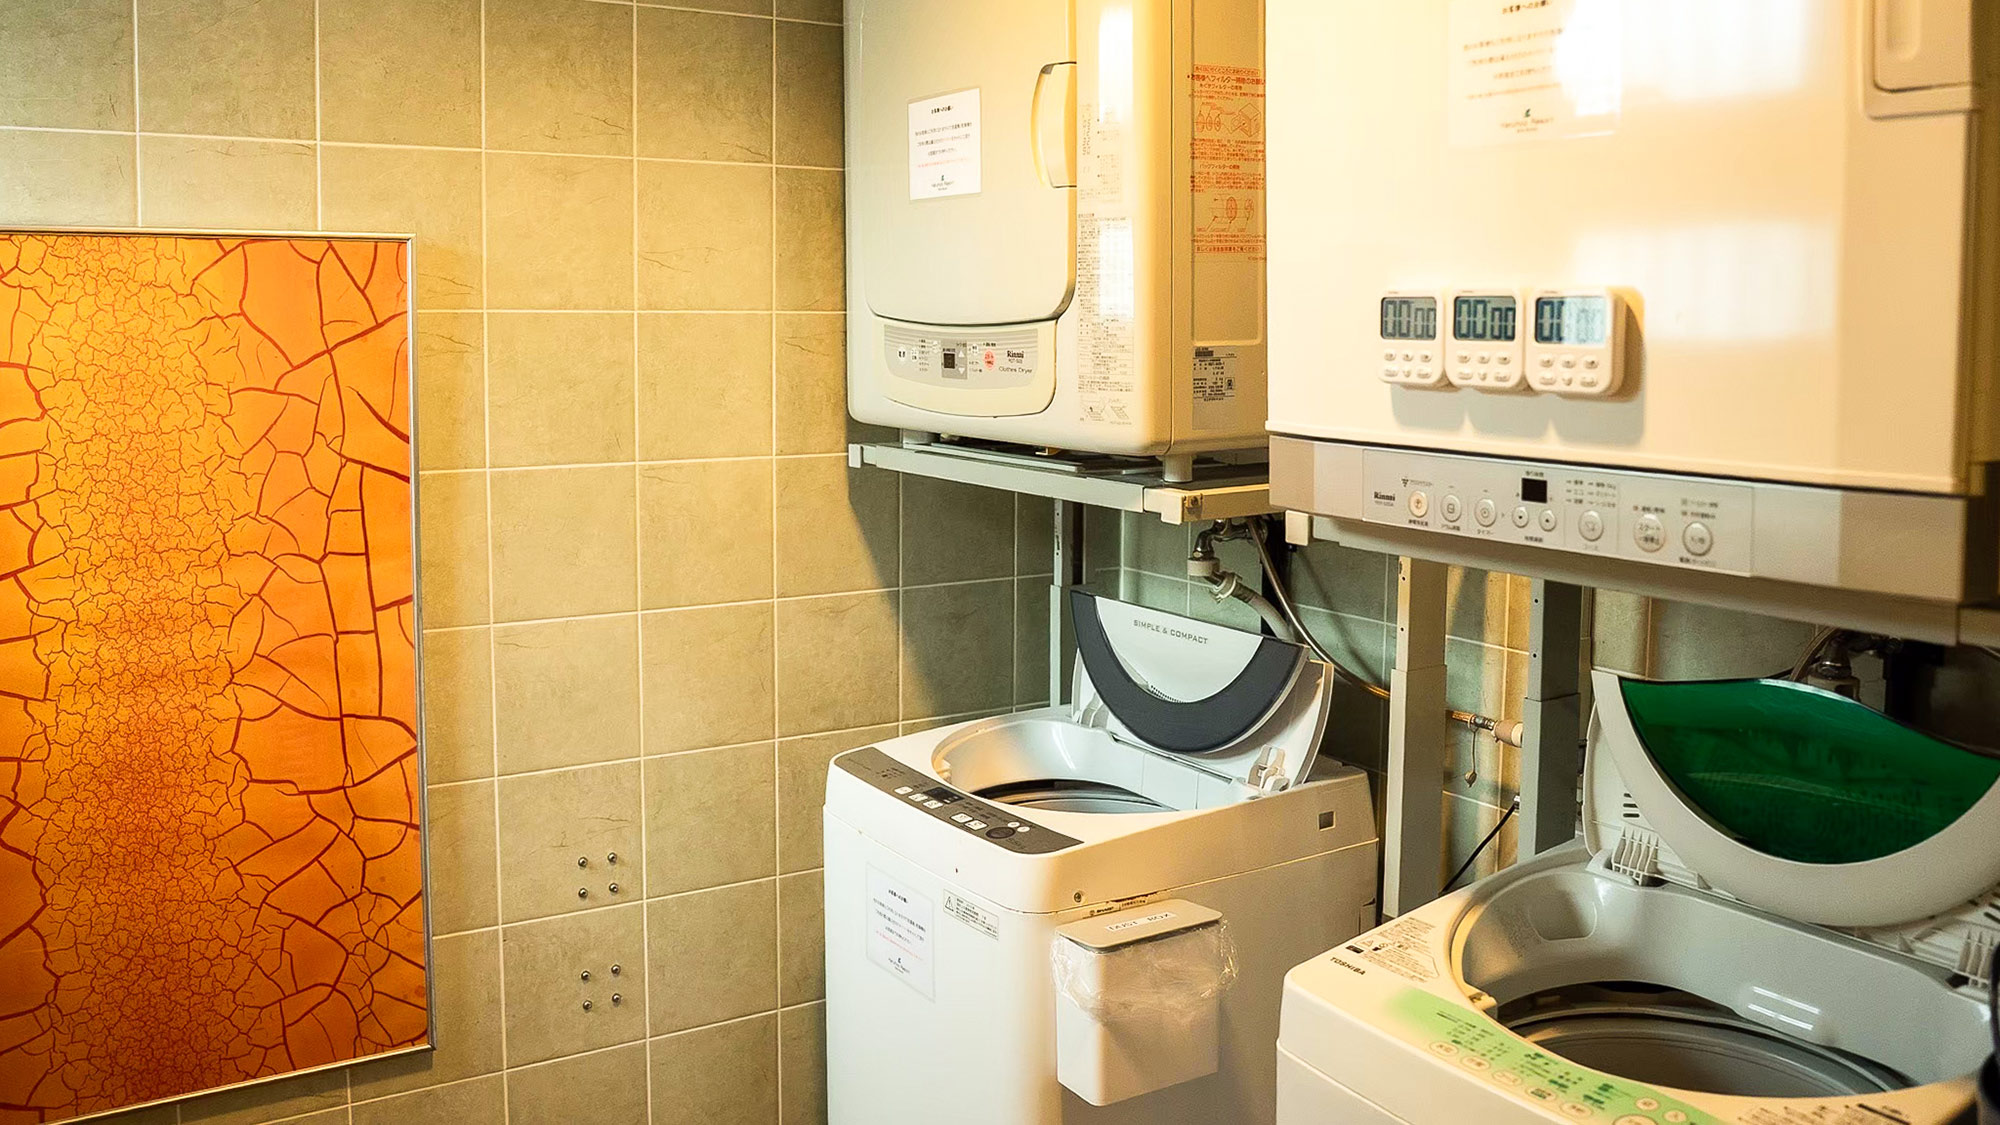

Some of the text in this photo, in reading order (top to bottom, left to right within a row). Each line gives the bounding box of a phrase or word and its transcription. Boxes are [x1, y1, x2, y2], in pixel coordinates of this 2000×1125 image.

[1006, 350, 1025, 359] Rinnai
[1374, 491, 1396, 501] Rinnai
[1133, 619, 1161, 632] SIMPLE
[1170, 629, 1208, 644] COMPACT
[1330, 956, 1366, 975] TOSHIBA
